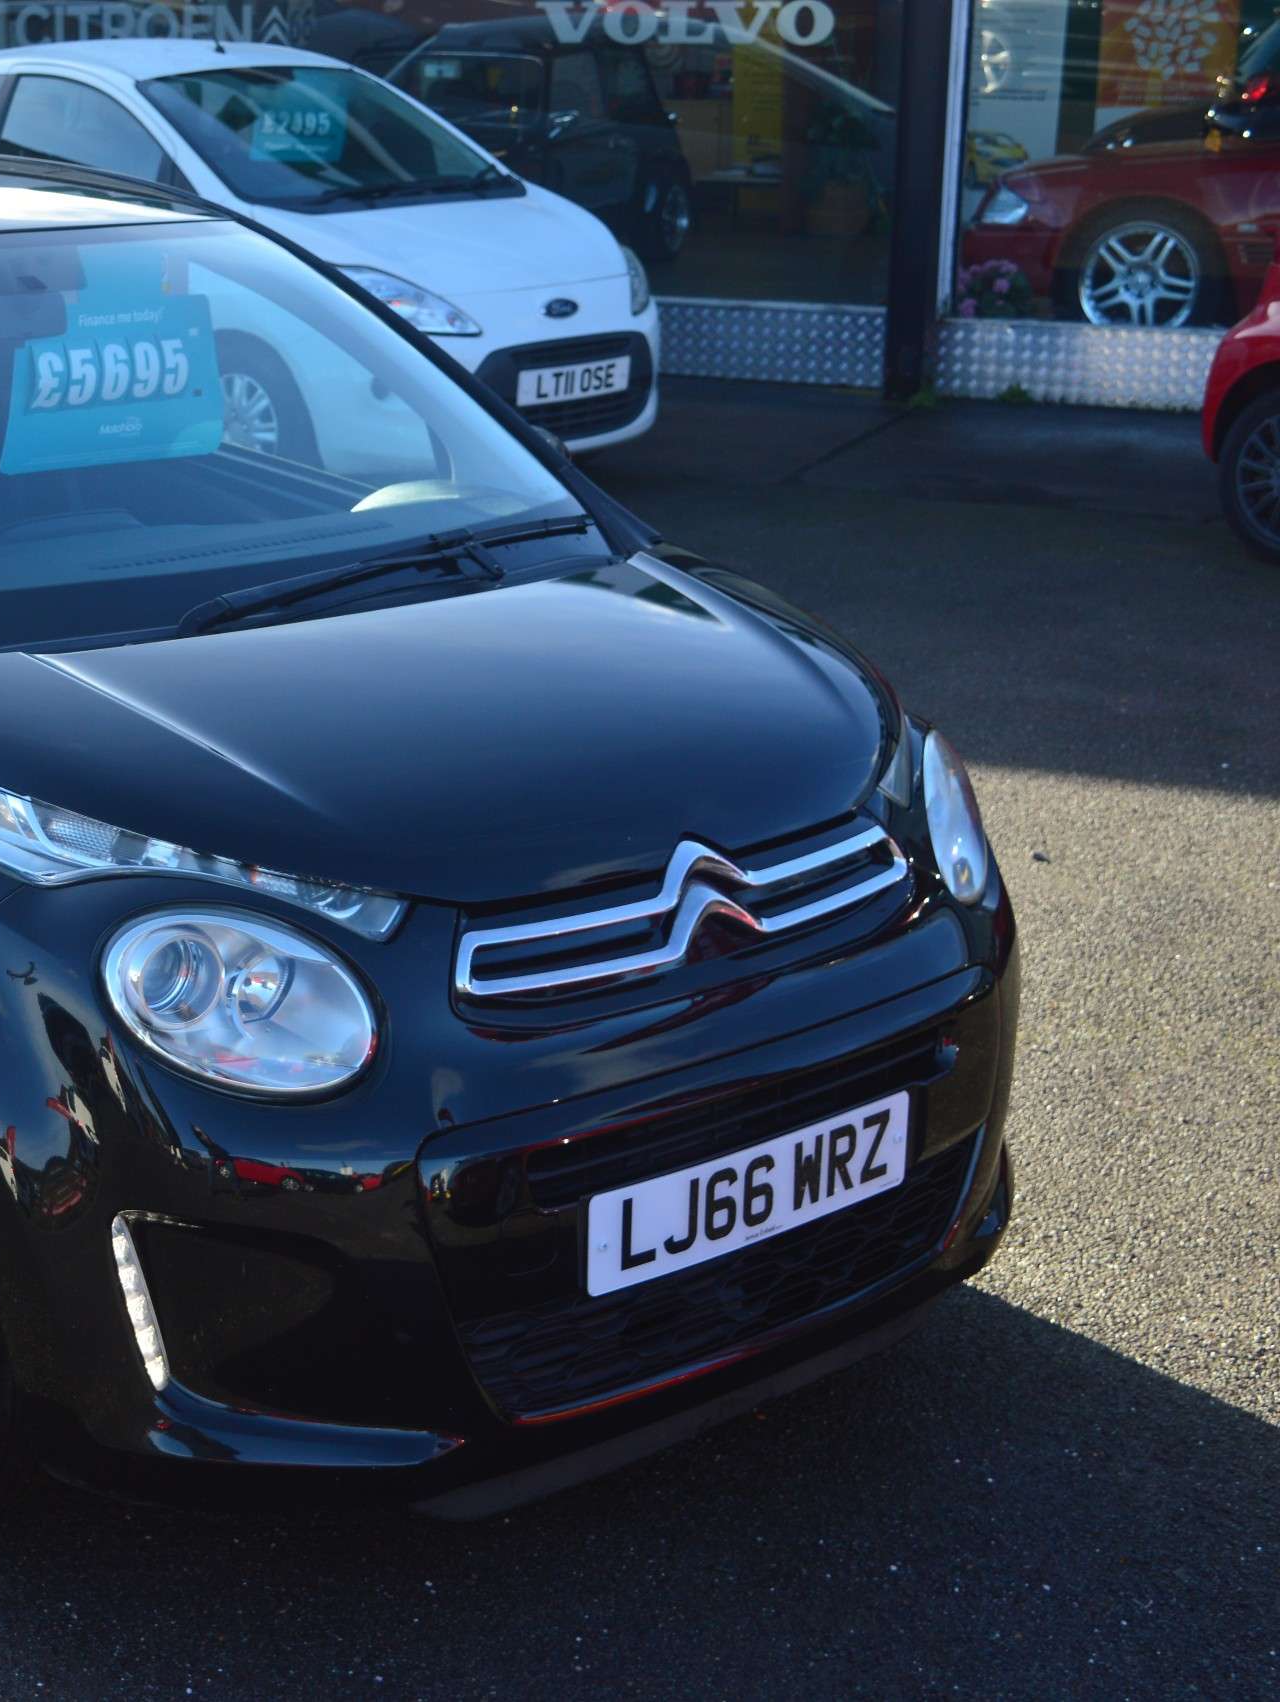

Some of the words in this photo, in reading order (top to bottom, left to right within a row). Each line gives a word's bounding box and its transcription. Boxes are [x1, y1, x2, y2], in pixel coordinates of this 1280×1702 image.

[535, 0, 835, 46] VOLVO
[117, 313, 131, 323] me
[31, 338, 189, 409] £5695
[621, 1154, 776, 1271] LJ66
[793, 1108, 891, 1211] WRZ
